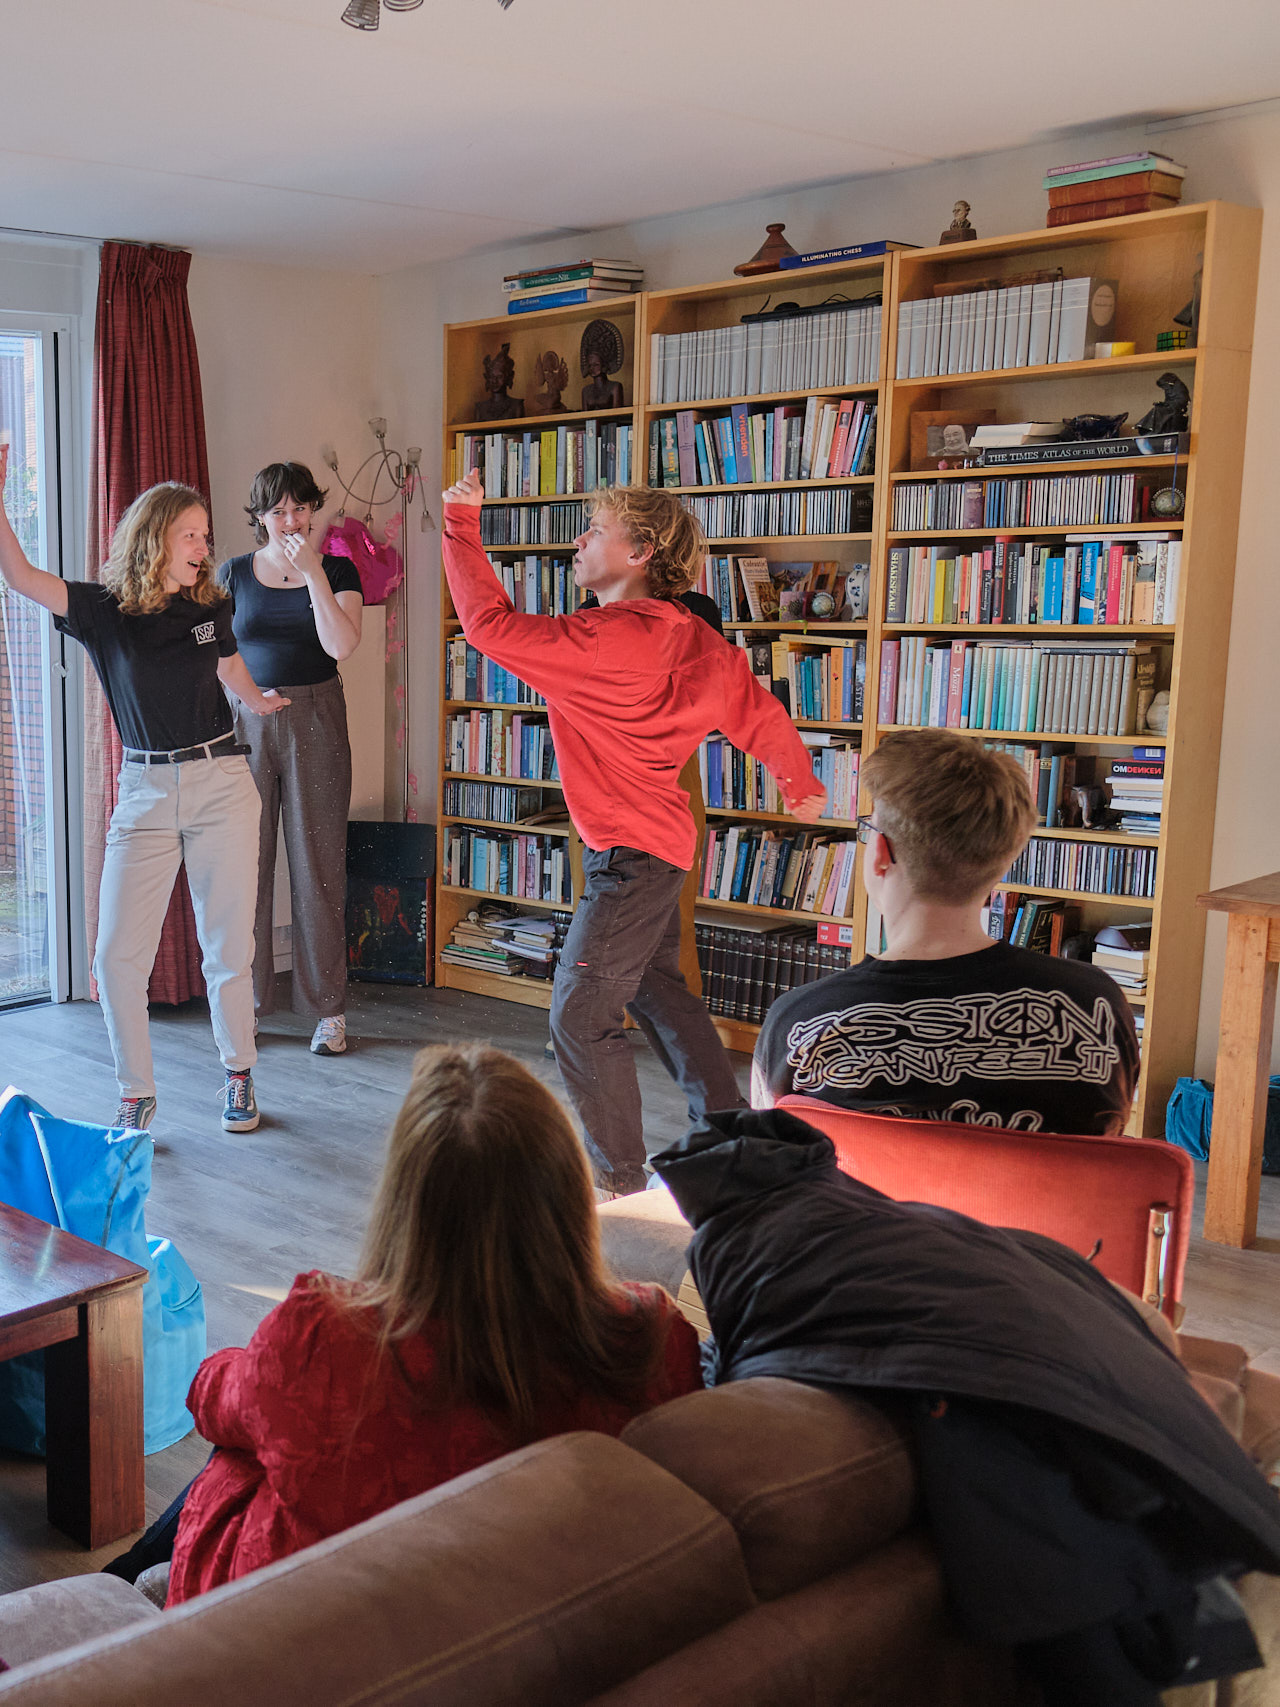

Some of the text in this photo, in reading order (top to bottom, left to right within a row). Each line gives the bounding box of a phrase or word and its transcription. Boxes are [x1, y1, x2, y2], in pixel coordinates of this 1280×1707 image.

[801, 247, 862, 262] ILLUMINATING CHESS
[987, 444, 1130, 463] THE TIMES ATLAS OF THE WORLD
[888, 551, 898, 614] SHAKESPEARE
[191, 621, 216, 645] TSGP
[951, 667, 961, 696] Mozart
[855, 686, 863, 707] STYX
